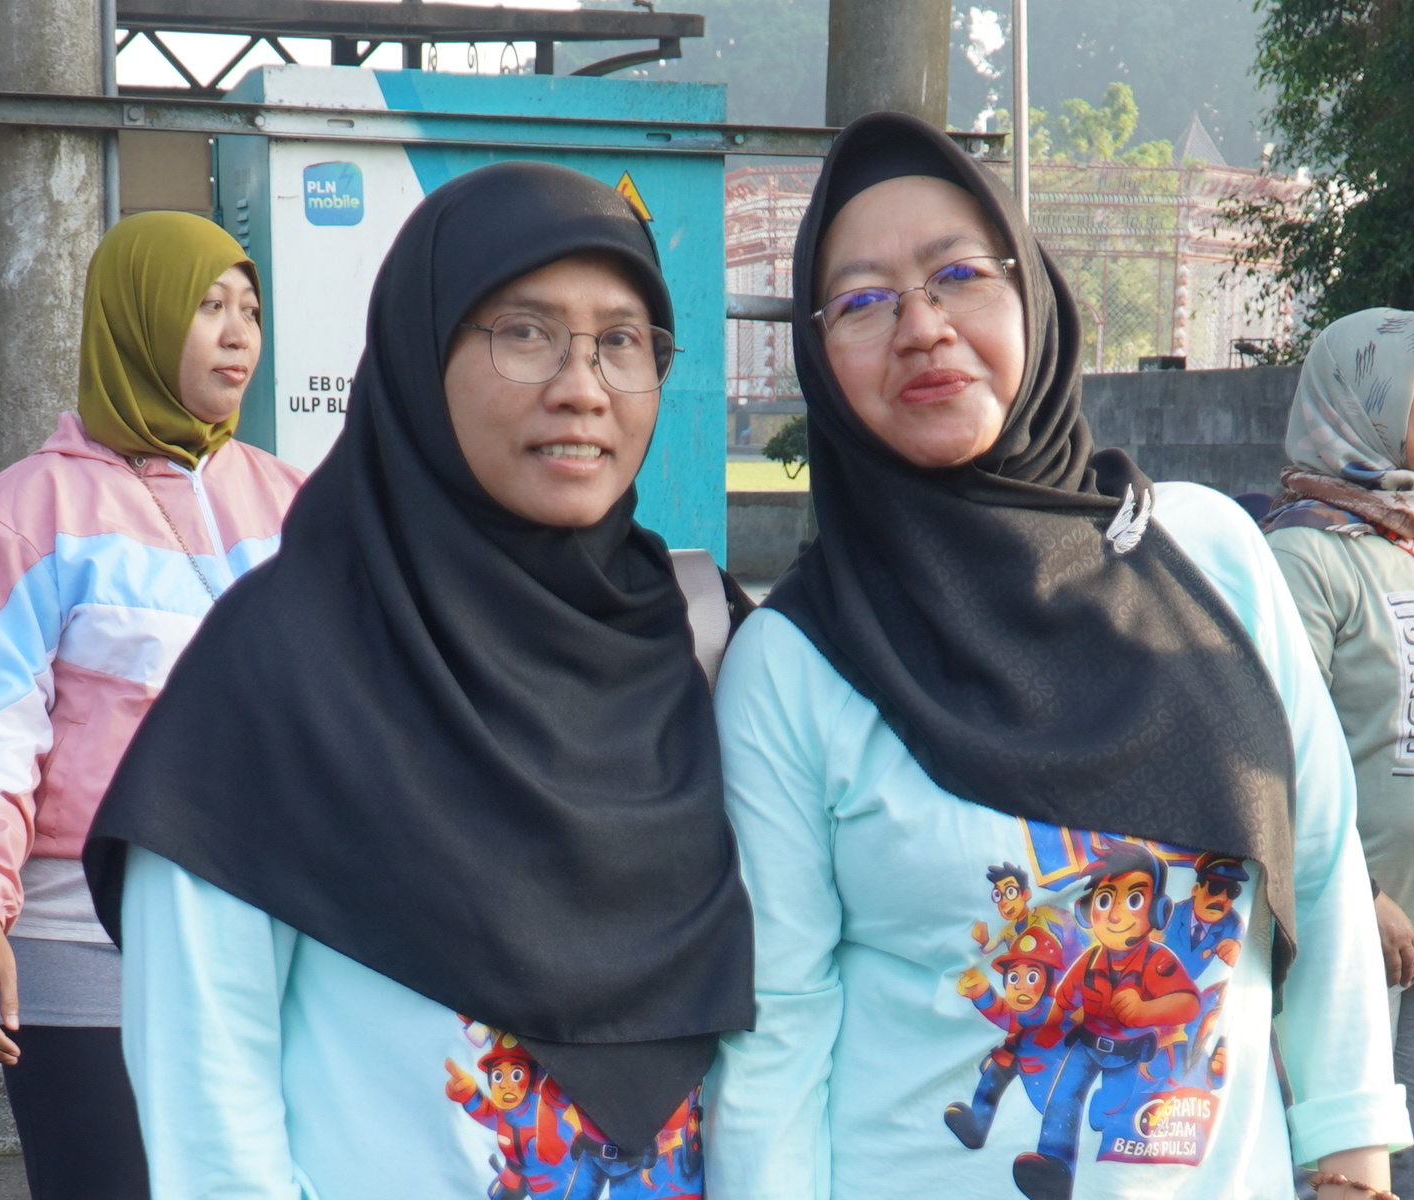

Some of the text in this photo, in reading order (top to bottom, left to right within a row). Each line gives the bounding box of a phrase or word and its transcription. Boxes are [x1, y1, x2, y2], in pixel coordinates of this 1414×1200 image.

[307, 181, 336, 193] PLN
[308, 194, 360, 209] mobile
[309, 376, 330, 391] EB
[289, 396, 347, 413] ULP BL
[1163, 1096, 1211, 1118] GRATIS
[1168, 1122, 1196, 1138] JAM
[1113, 1138, 1196, 1157] BEBAS PULSA
